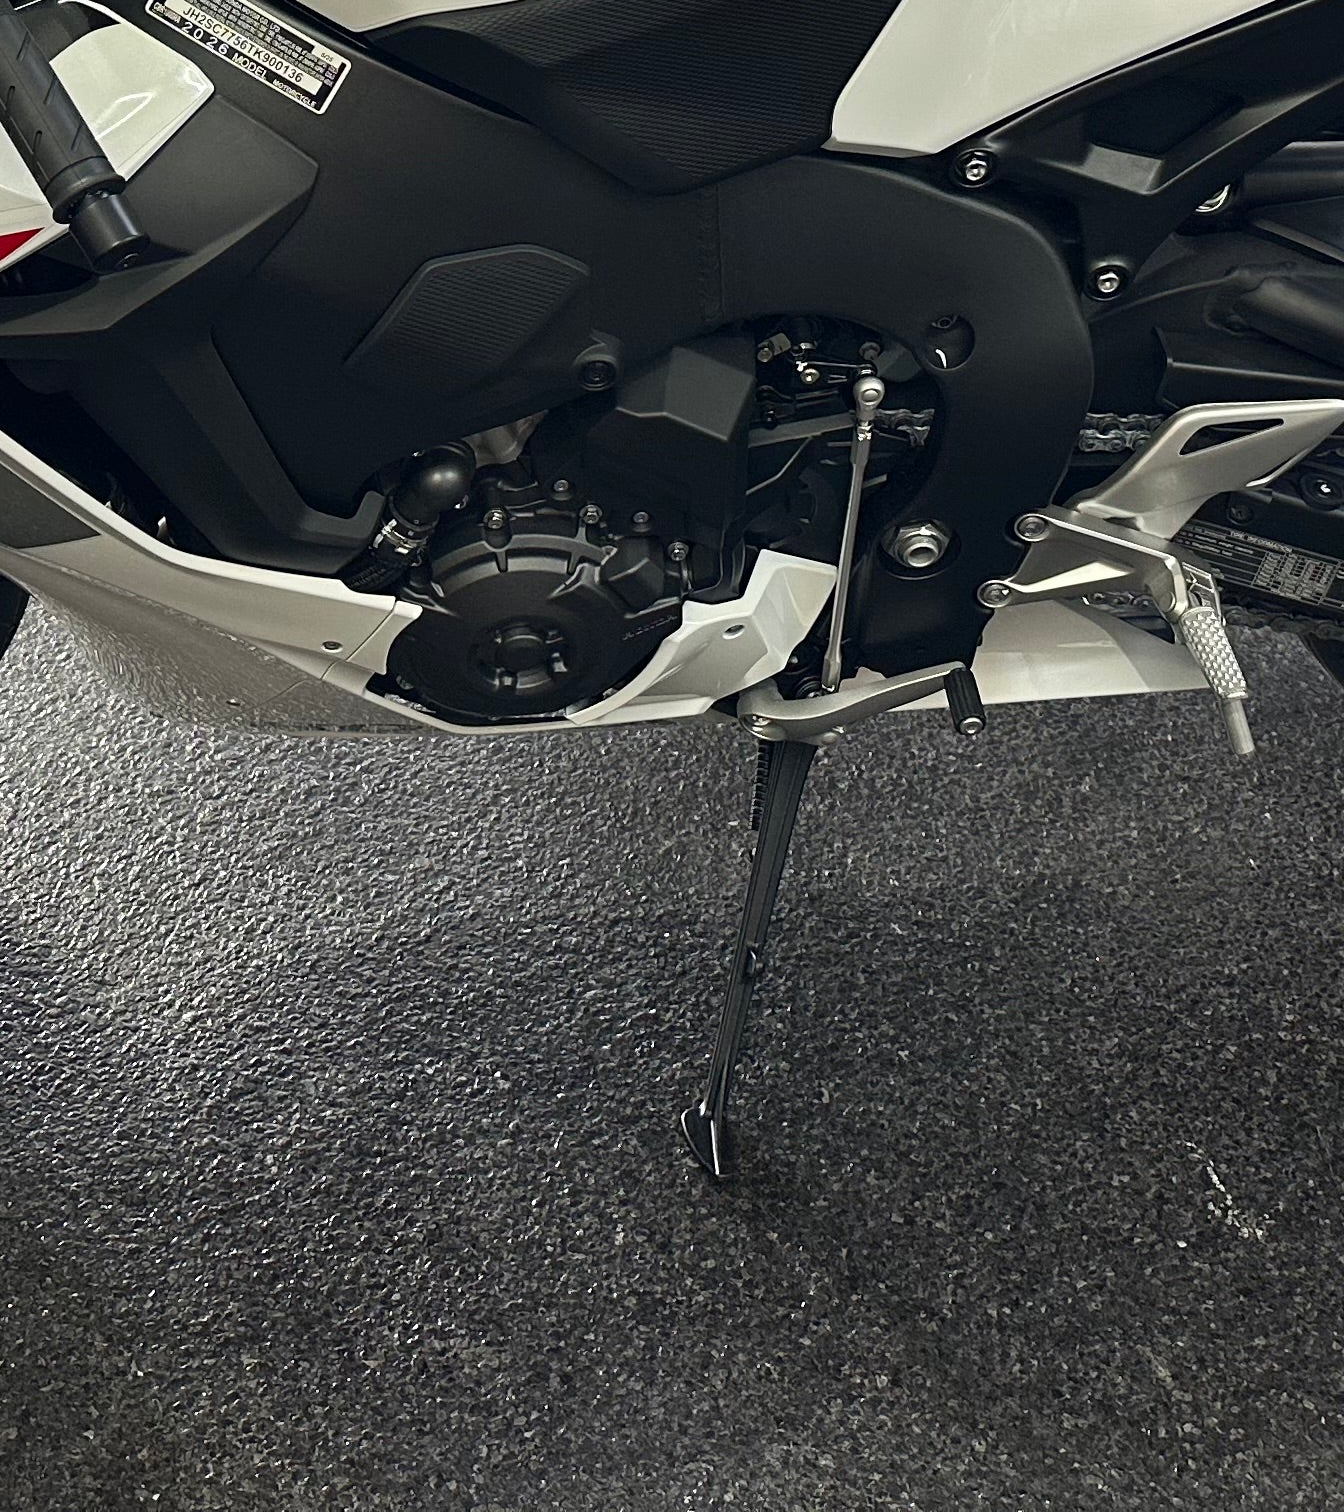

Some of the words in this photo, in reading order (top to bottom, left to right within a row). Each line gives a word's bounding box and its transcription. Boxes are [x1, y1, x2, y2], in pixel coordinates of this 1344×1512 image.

[182, 6, 304, 83] JH2SC7756TK900136
[232, 52, 269, 81] MODEL
[272, 79, 317, 108] MOTORCYCLE
